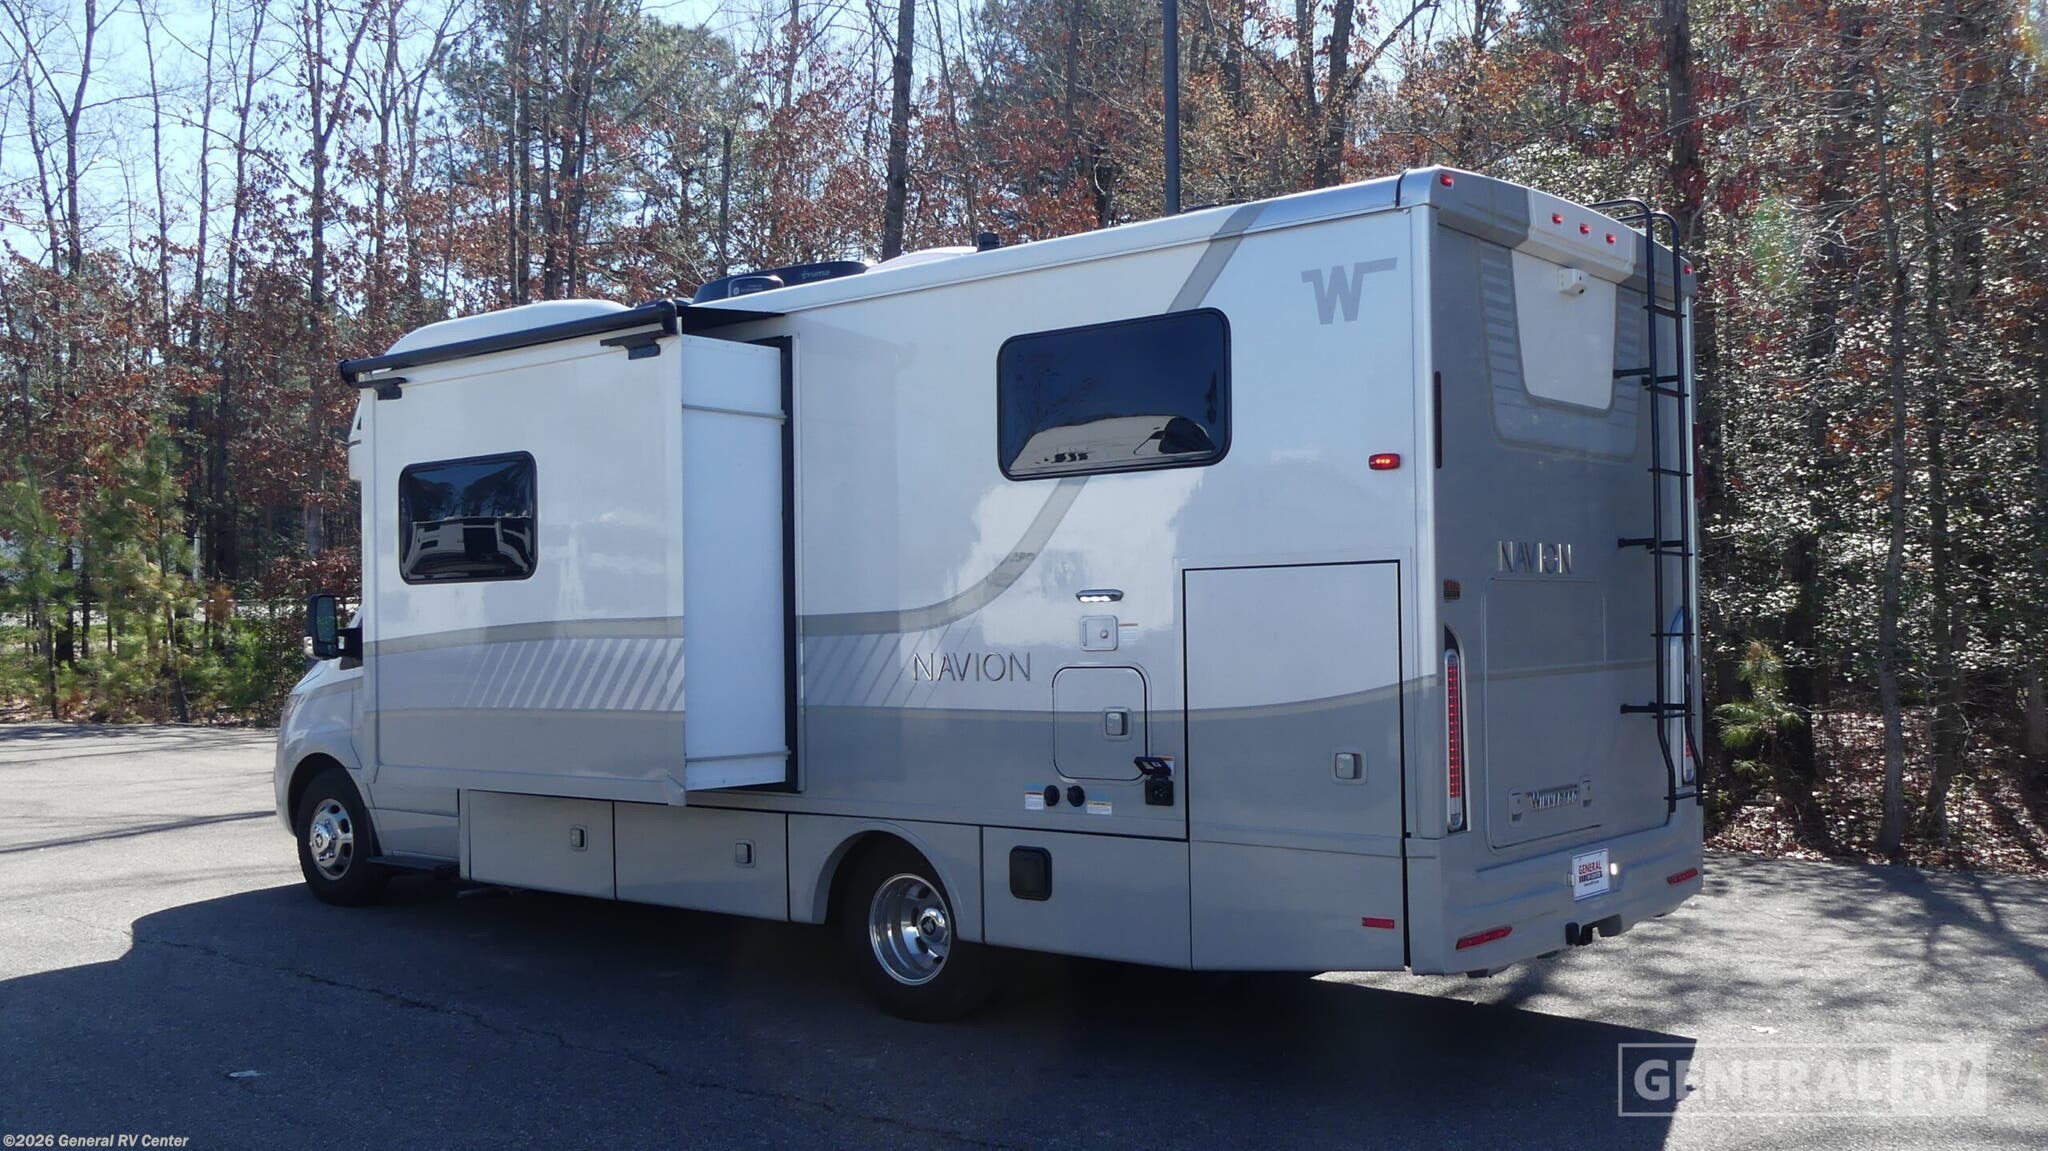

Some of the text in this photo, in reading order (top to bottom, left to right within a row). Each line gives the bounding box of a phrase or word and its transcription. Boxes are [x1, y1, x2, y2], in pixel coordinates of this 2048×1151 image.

[1498, 540, 1573, 574] NAVION
[914, 652, 1031, 682] NAVION
[1578, 860, 1602, 875] GENERAL
